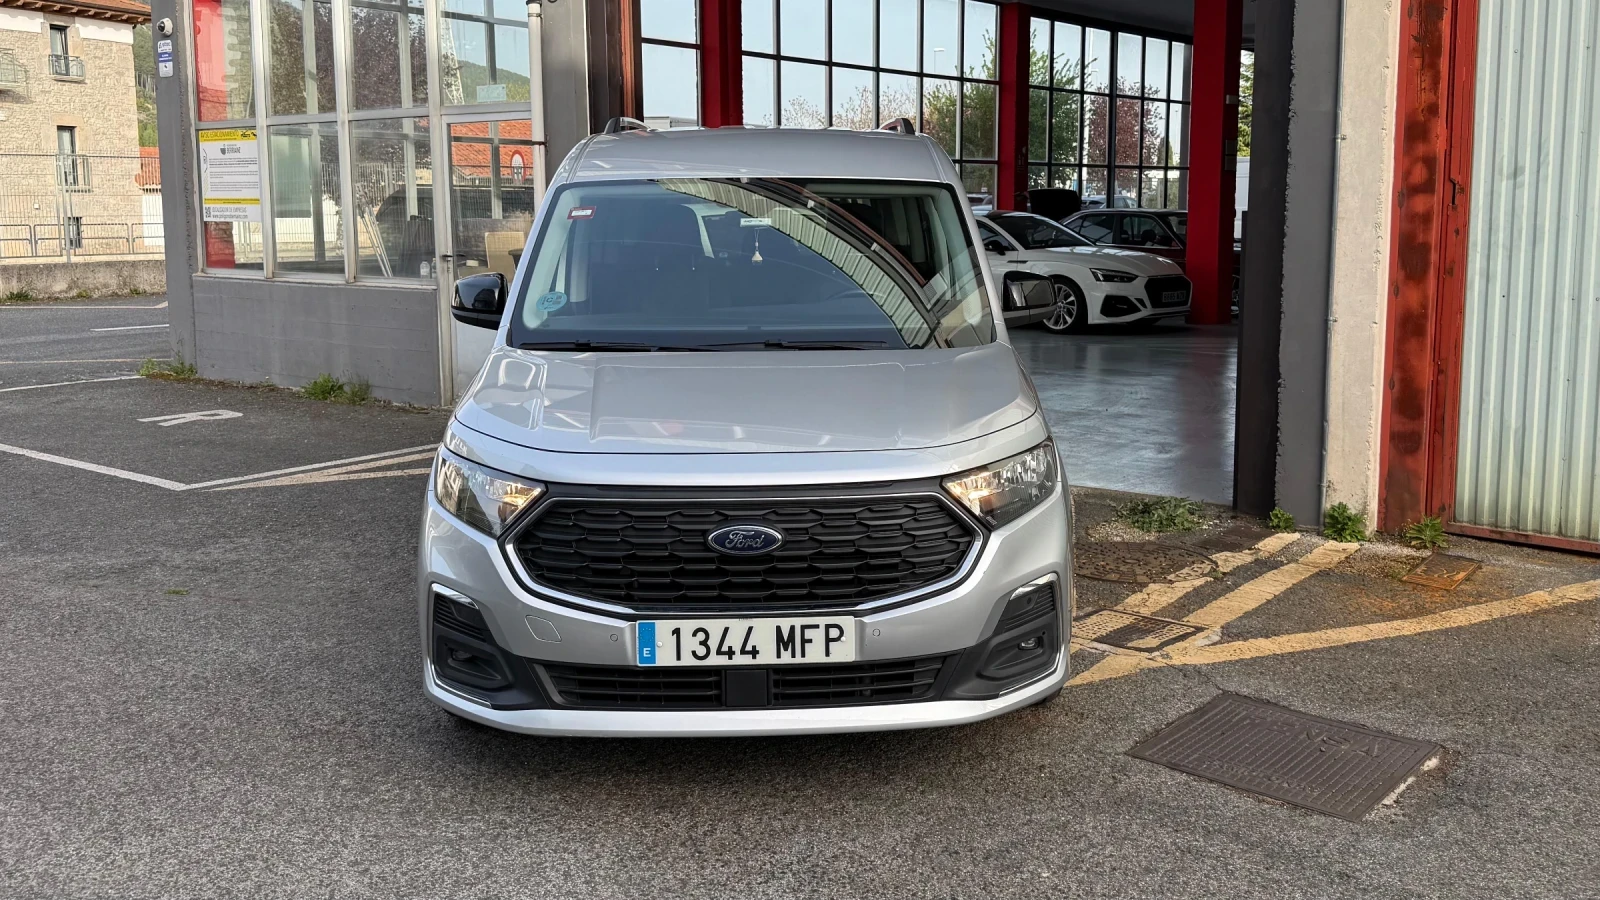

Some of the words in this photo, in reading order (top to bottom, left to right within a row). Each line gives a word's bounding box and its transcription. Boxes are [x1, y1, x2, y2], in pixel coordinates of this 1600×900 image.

[725, 530, 765, 548] Ford
[671, 625, 760, 662] 1344
[775, 623, 845, 659] MFP
[643, 647, 651, 657] E
